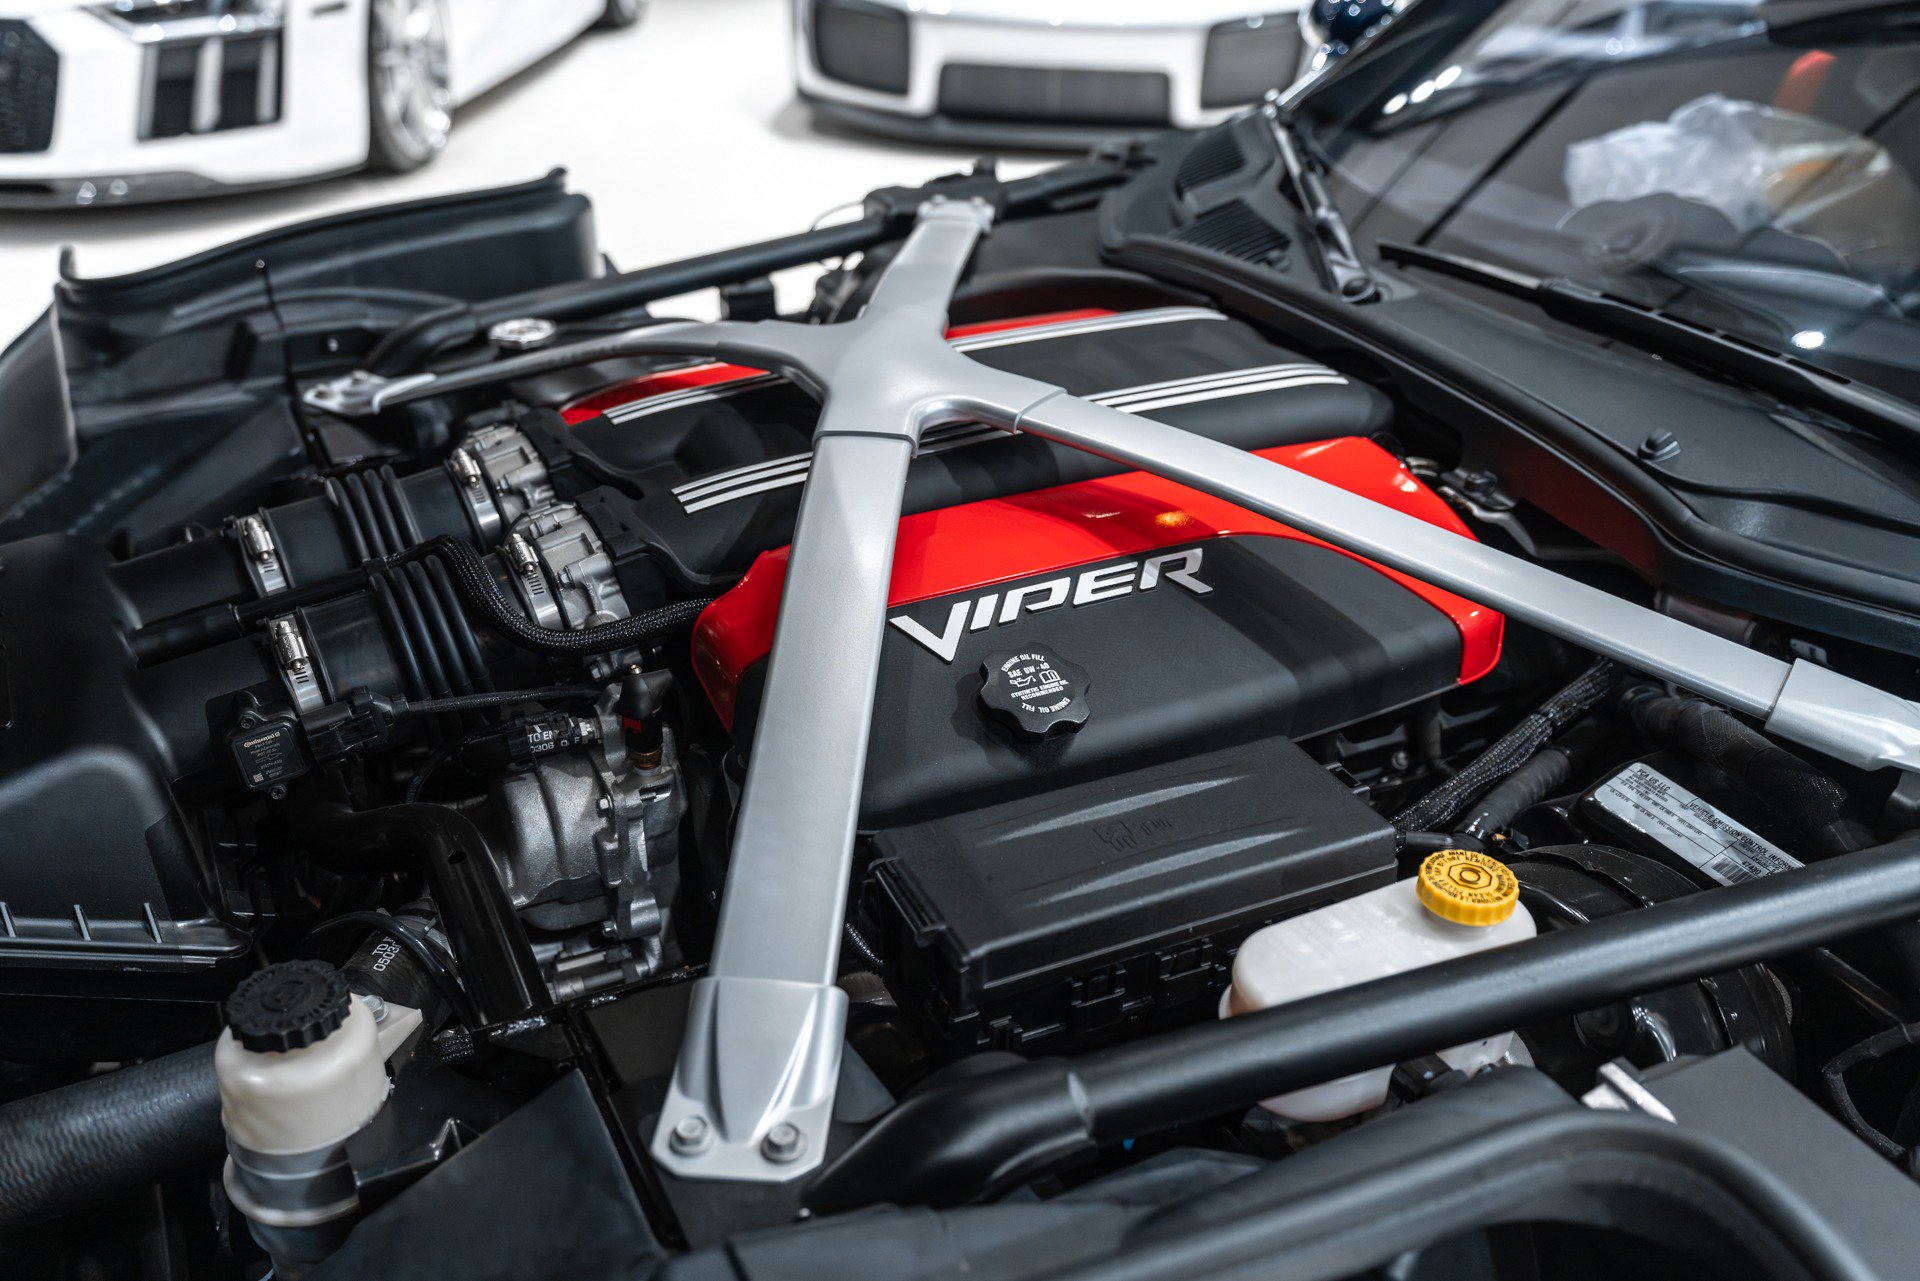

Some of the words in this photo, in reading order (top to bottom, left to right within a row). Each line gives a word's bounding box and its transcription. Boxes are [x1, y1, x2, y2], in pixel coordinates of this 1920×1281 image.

[889, 548, 1214, 662] VIPER
[1001, 656, 1020, 672] ENGINE
[1031, 654, 1045, 662] FILL
[1007, 669, 1022, 678] SAE
[1010, 687, 1039, 698] SYNTHETIC
[1039, 682, 1060, 690] ENGINE
[1021, 686, 1064, 700] RECOMMENDED
[1022, 702, 1035, 712] FILL
[1049, 697, 1070, 712] ENGINE
[528, 733, 540, 743] TO
[1637, 769, 1649, 779] FCA
[1649, 776, 1659, 784] US
[1658, 782, 1670, 792] LLC
[1689, 802, 1714, 819] VEHICLE
[1714, 818, 1741, 837] EMISSION
[1740, 835, 1767, 856] CONTROL
